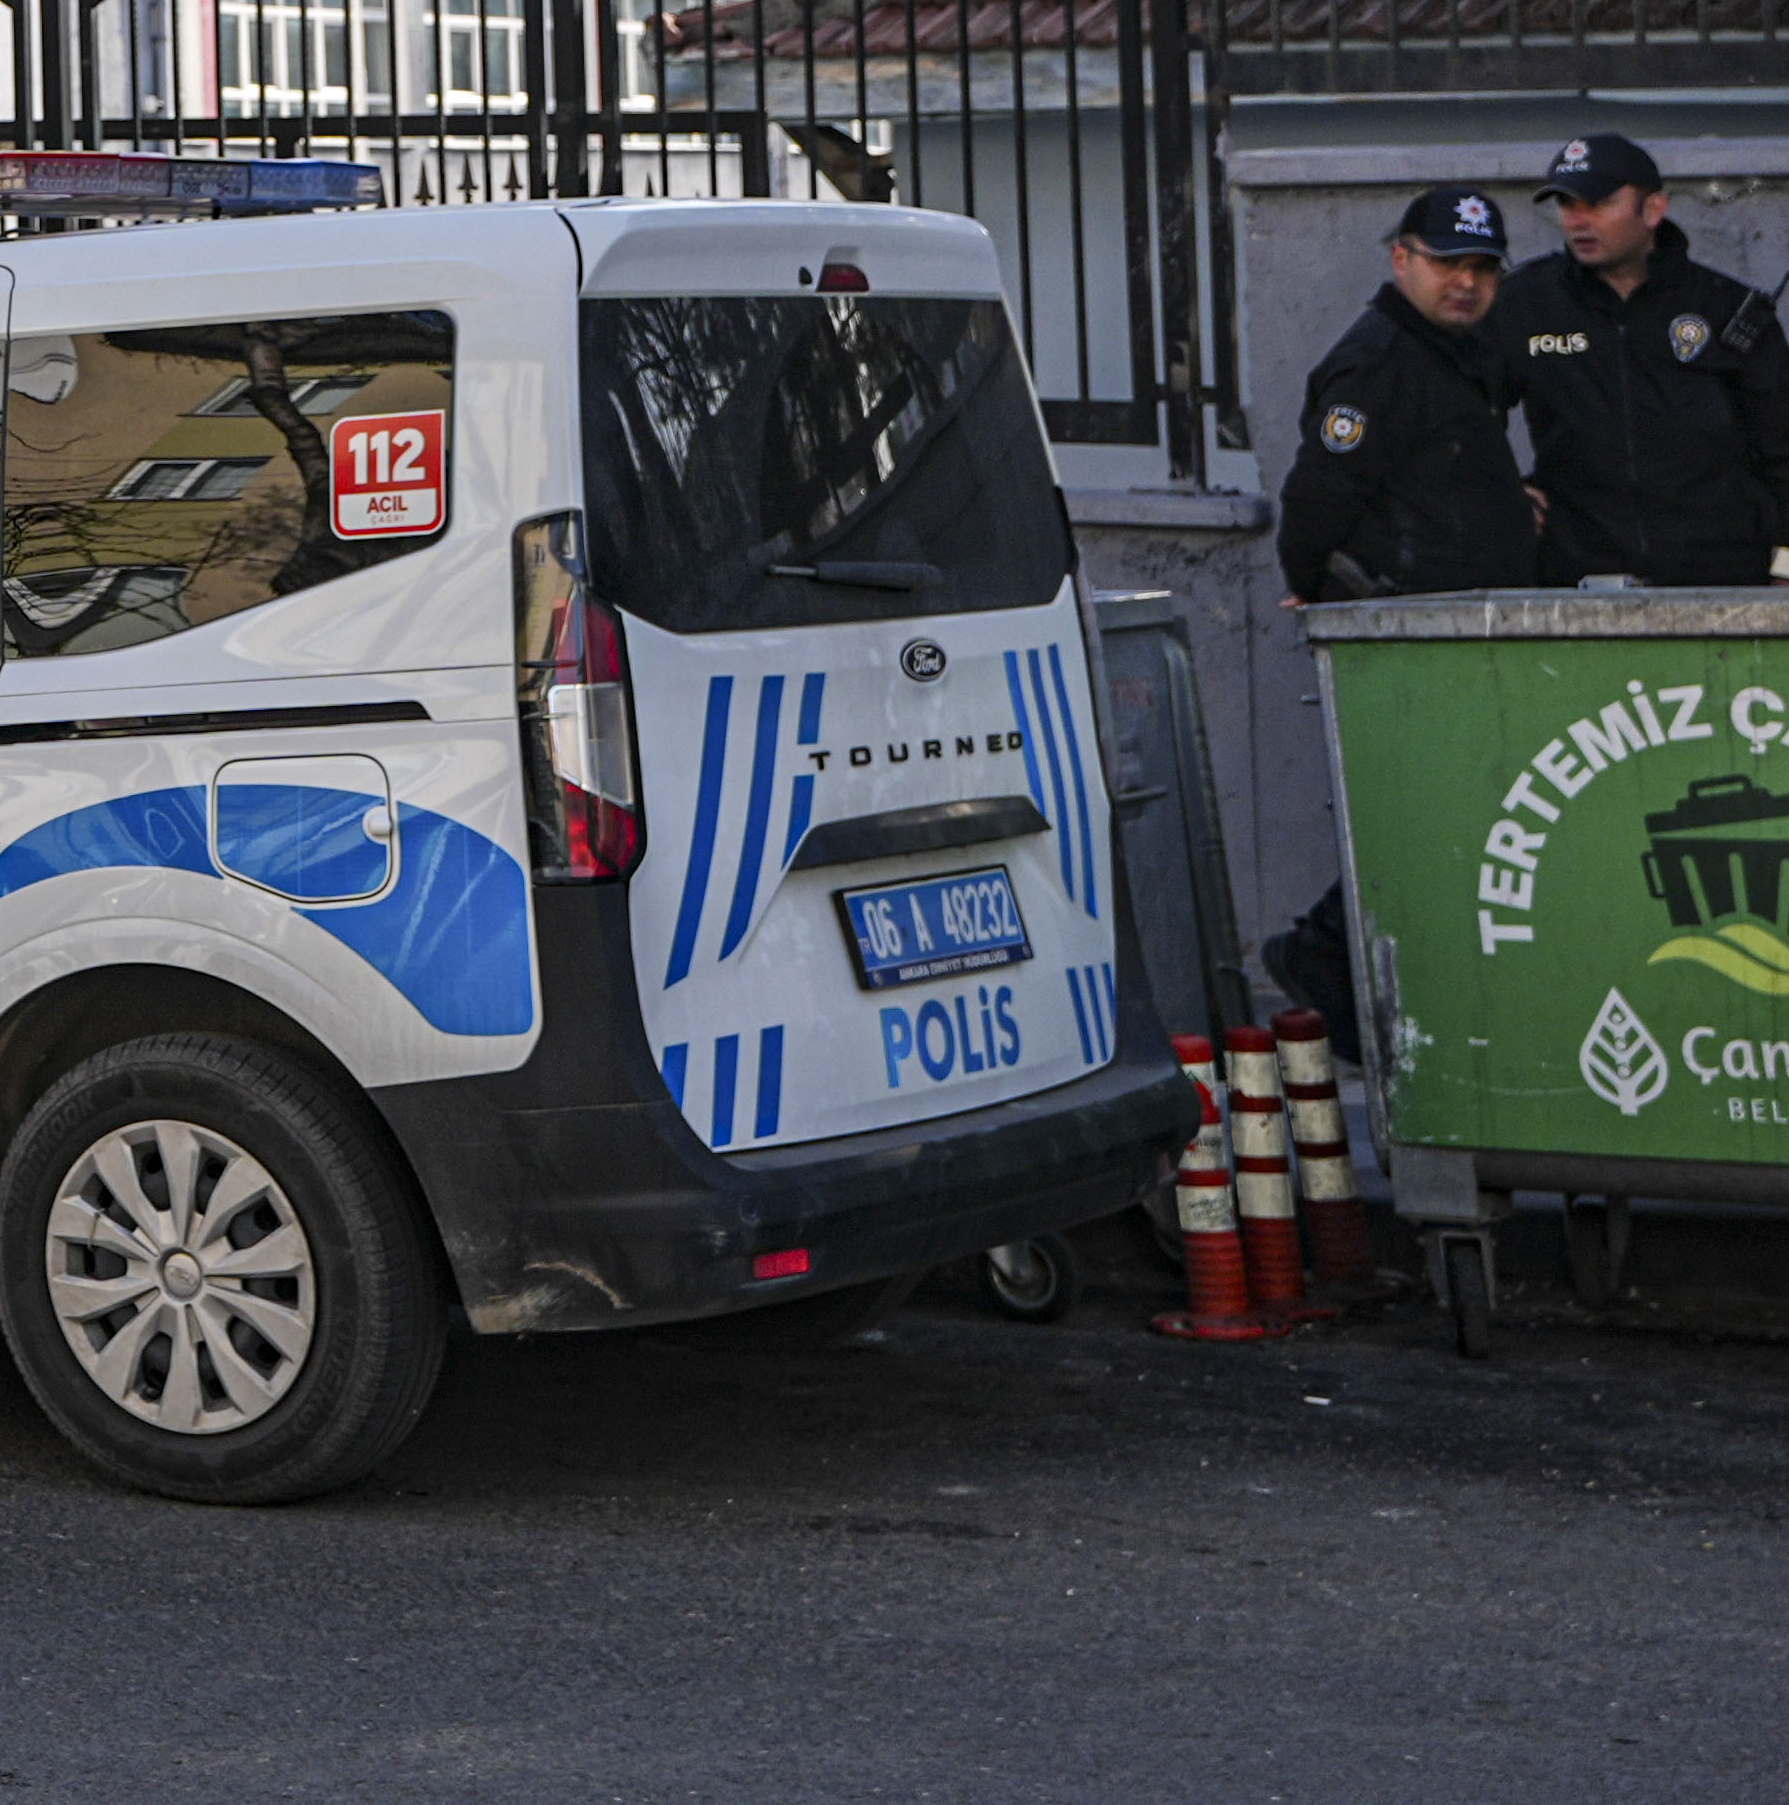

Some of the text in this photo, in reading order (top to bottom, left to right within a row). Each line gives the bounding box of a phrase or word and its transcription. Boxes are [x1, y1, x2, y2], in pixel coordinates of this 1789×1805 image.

[348, 427, 426, 485] 112
[1478, 679, 1713, 956] TERTEMİZ
[862, 899, 902, 959] 06
[909, 893, 935, 952] A
[941, 879, 1019, 945] 48232
